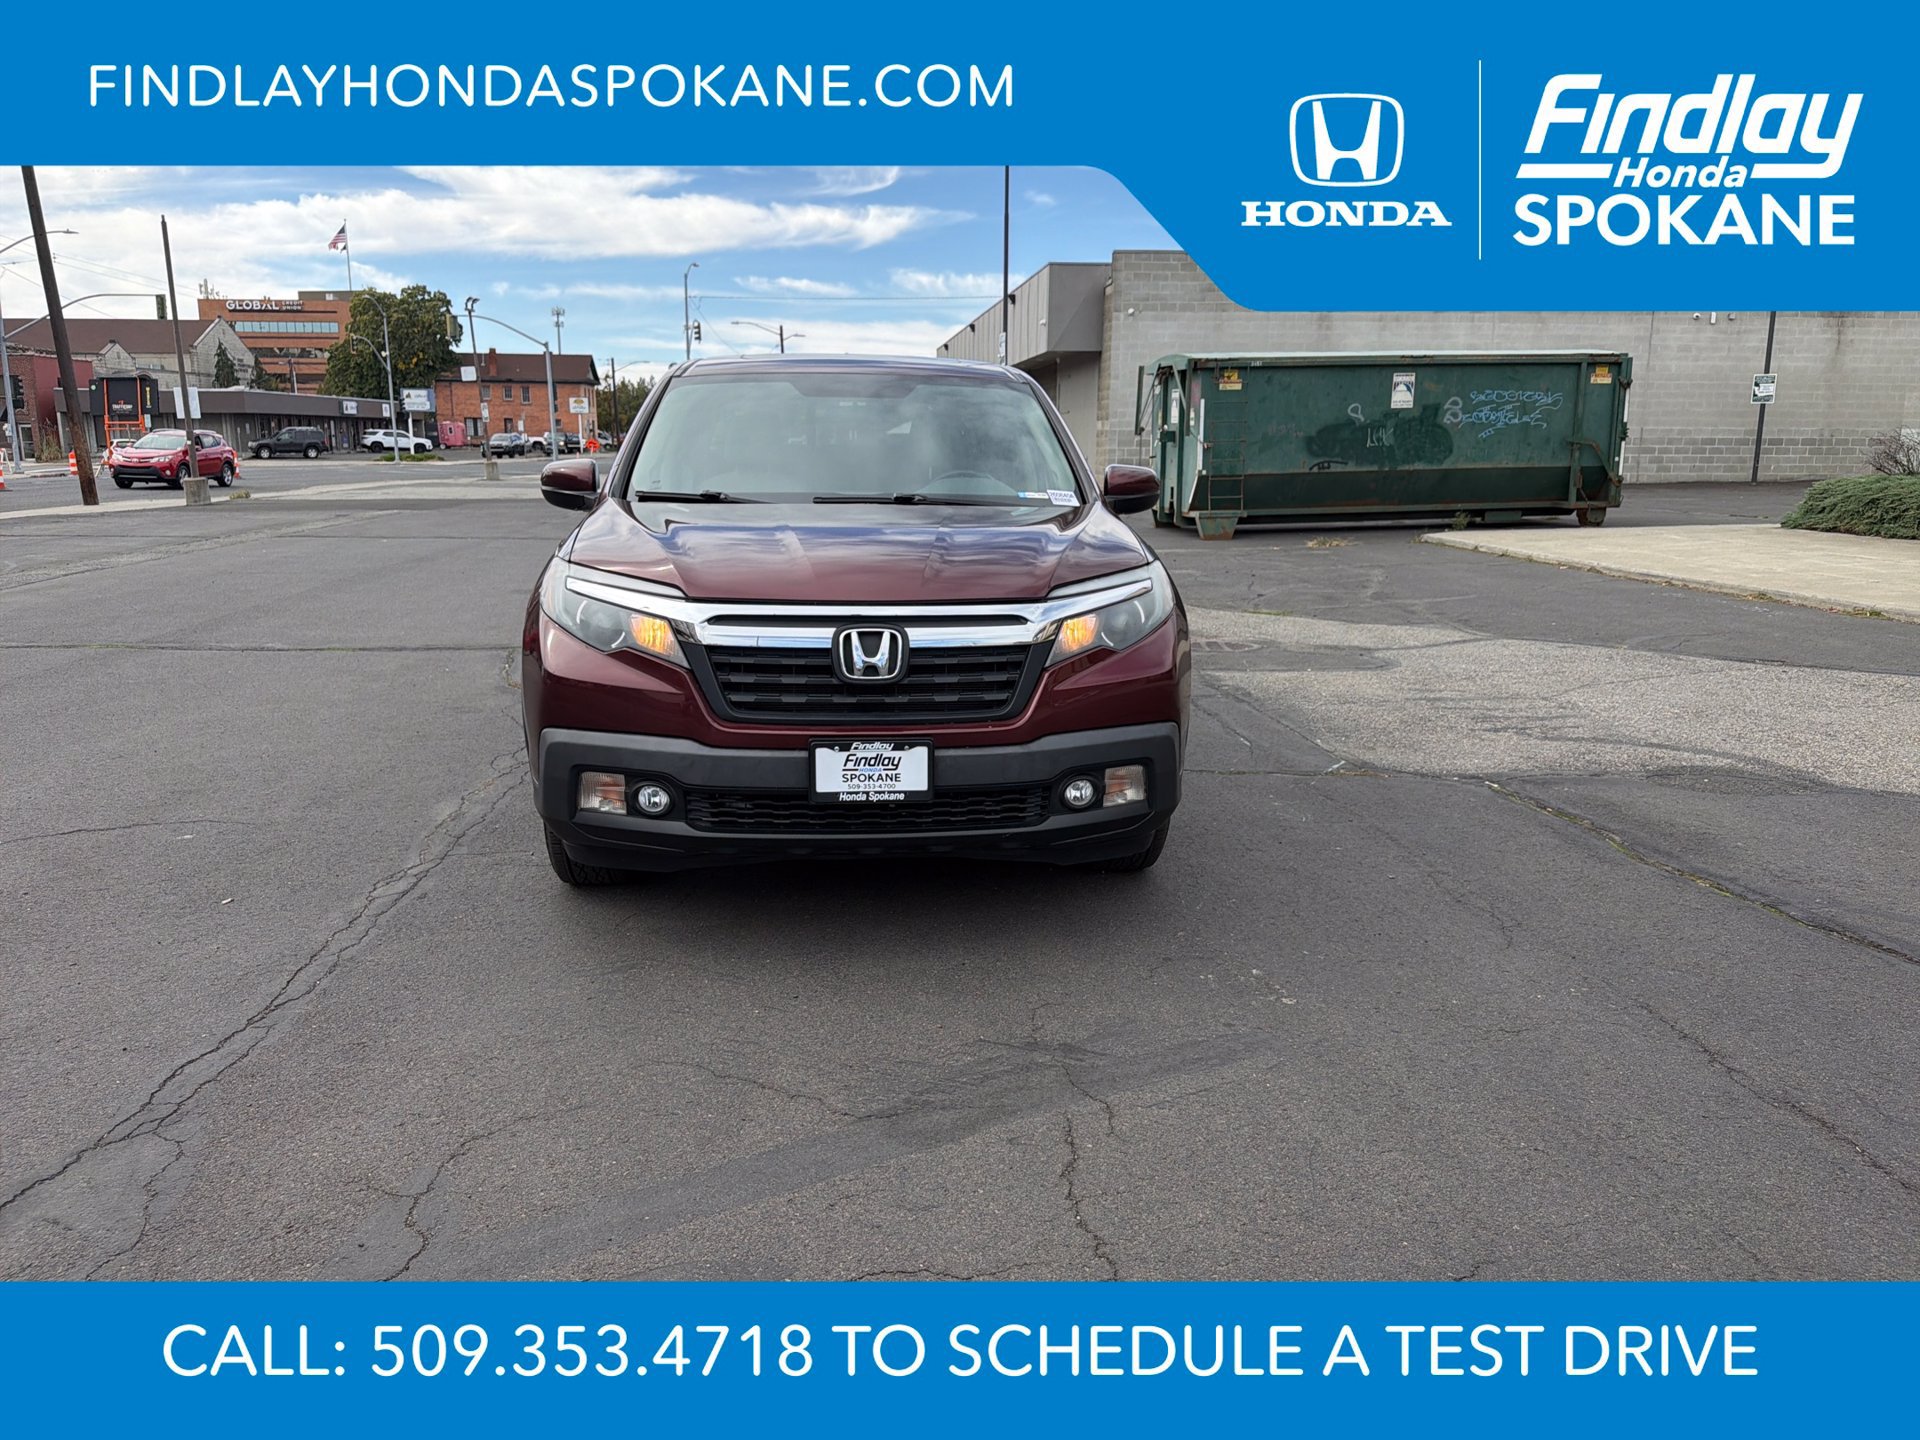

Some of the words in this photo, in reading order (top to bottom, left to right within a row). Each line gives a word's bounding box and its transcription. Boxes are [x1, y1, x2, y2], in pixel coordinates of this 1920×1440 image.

[226, 299, 279, 310] GLOBAL
[849, 742, 894, 752] Findlay
[842, 753, 902, 772] Findlay
[842, 773, 902, 783] SPOKANE
[839, 792, 867, 802] Honda
[868, 791, 905, 802] Spokane
